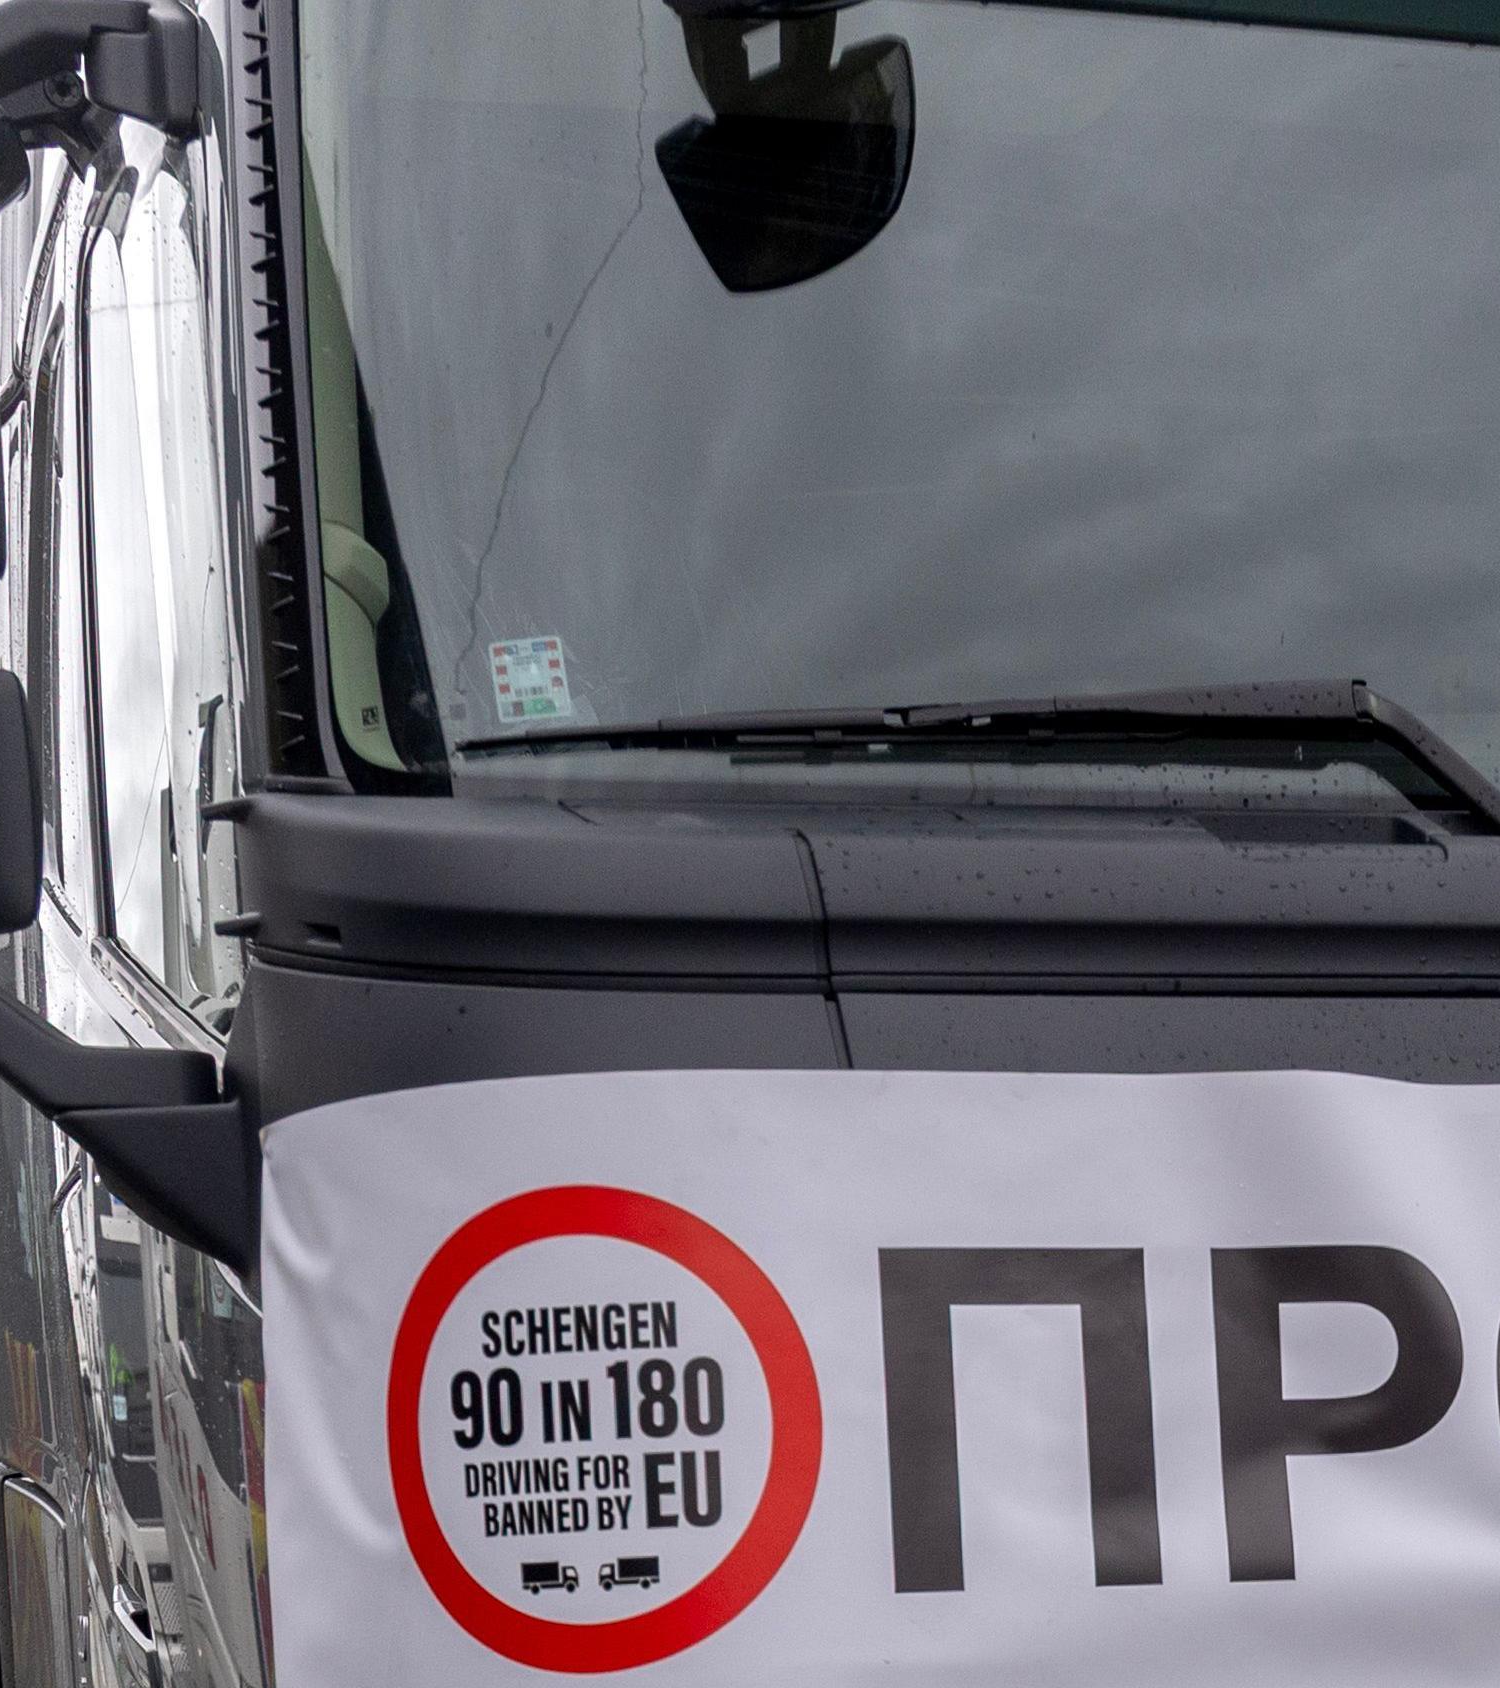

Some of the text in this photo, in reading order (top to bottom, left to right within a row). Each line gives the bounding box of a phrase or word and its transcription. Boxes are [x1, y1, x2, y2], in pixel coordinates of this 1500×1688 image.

[482, 1301, 678, 1358] SCHENGEN
[451, 1356, 725, 1450] 90 IN 180
[464, 1450, 723, 1529] DRIVING FOR EU
[484, 1495, 632, 1537] BANNED BY
